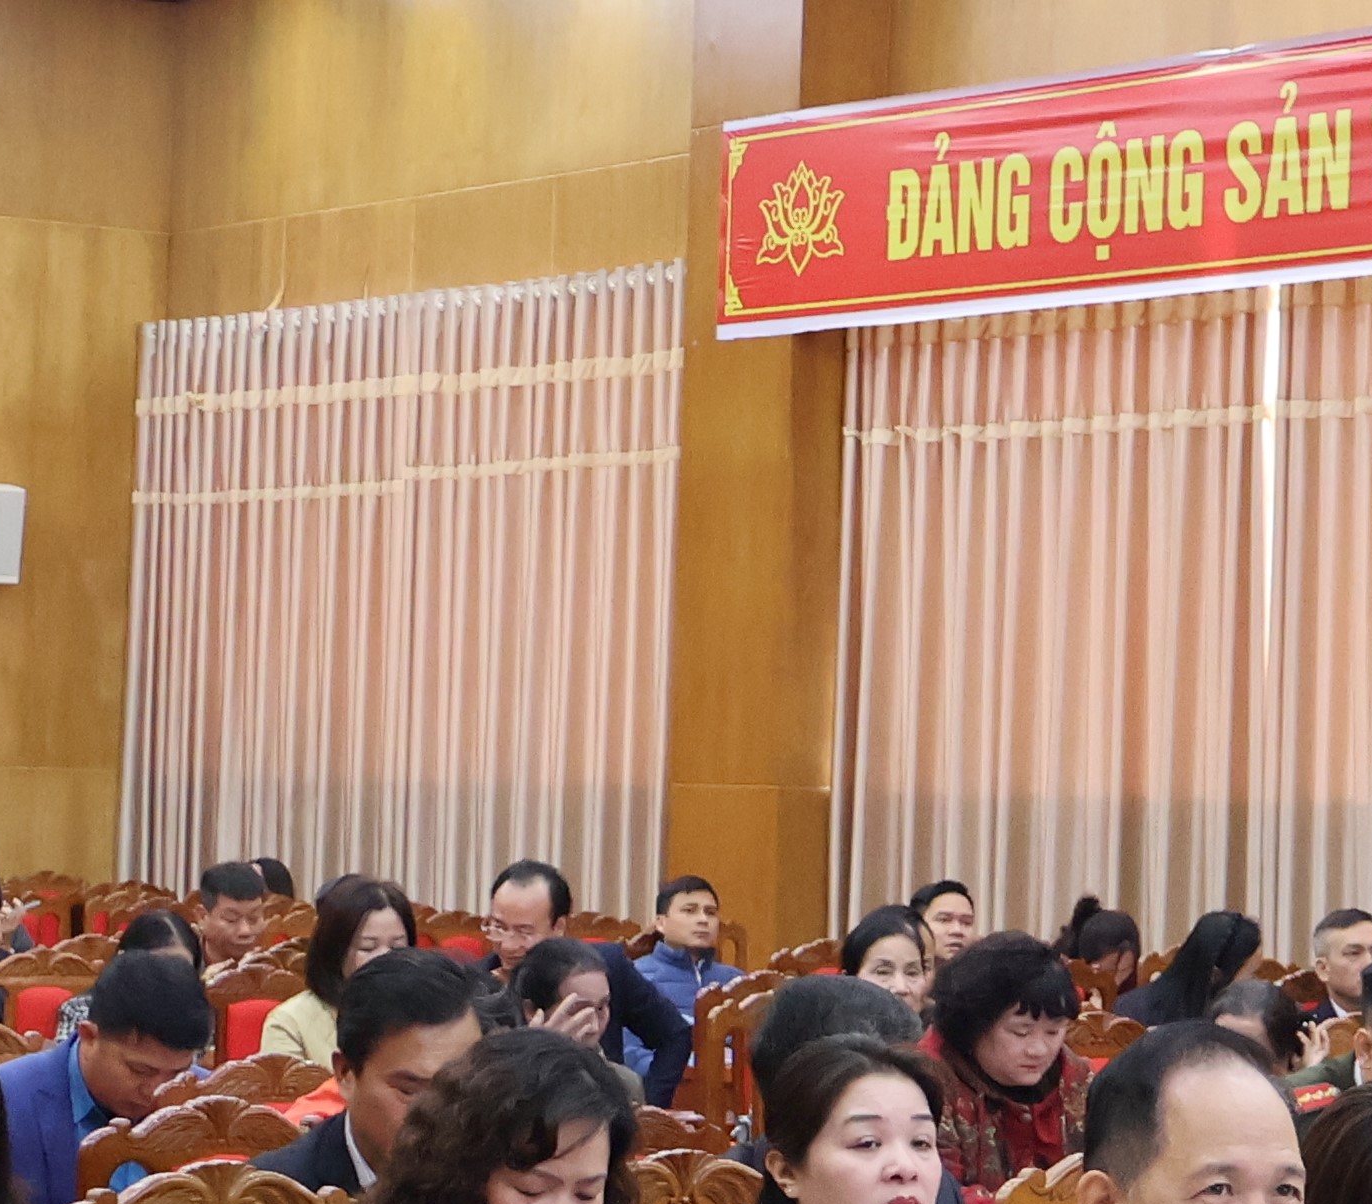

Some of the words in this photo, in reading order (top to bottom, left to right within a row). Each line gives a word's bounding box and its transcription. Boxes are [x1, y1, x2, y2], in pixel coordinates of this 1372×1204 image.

[885, 131, 1030, 262] ĐẢNG
[1049, 121, 1204, 262] CỘNG
[1223, 80, 1352, 224] SẢN
